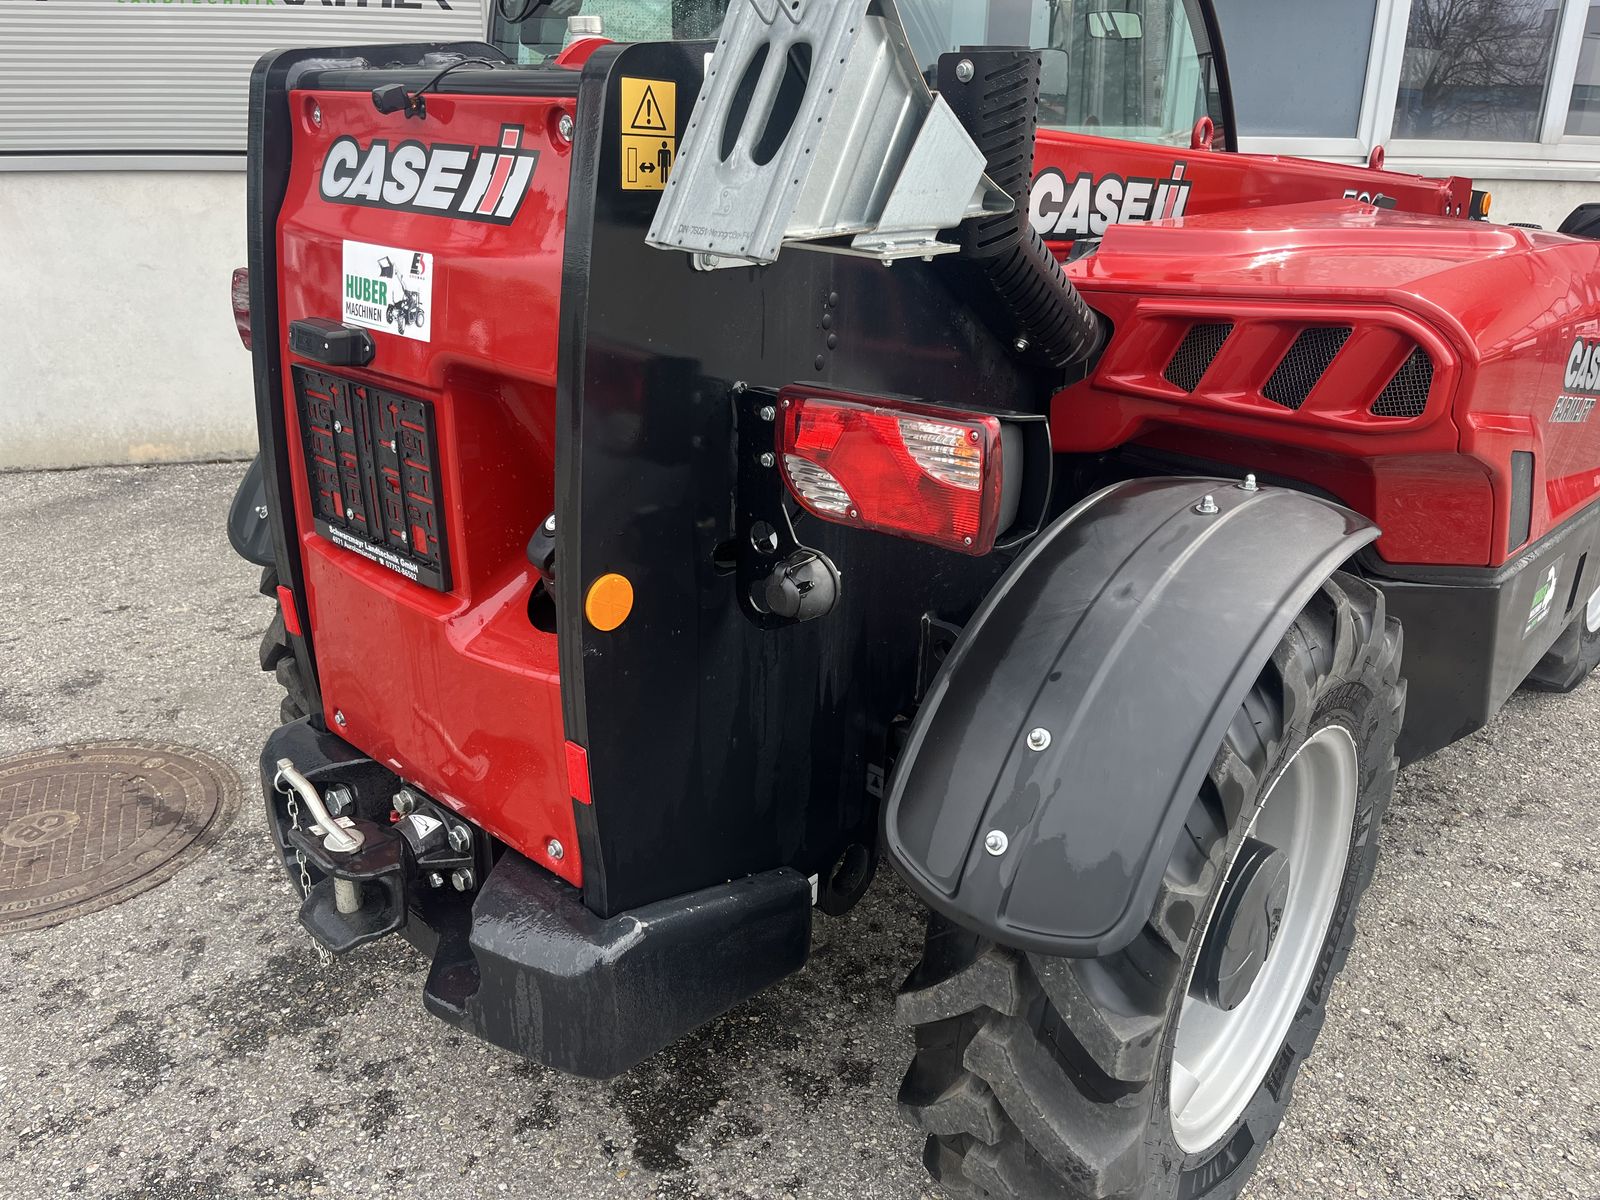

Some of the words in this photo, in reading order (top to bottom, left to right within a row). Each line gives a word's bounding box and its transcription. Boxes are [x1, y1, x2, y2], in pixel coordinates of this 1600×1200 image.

[321, 139, 470, 210] CASE
[1028, 172, 1153, 236] CASE
[345, 273, 388, 307] HUBER
[345, 301, 382, 323] MASCHINEN
[364, 541, 400, 565] Landtechnik
[399, 558, 419, 573] GmbH
[1309, 846, 1365, 998] MICHELIN
